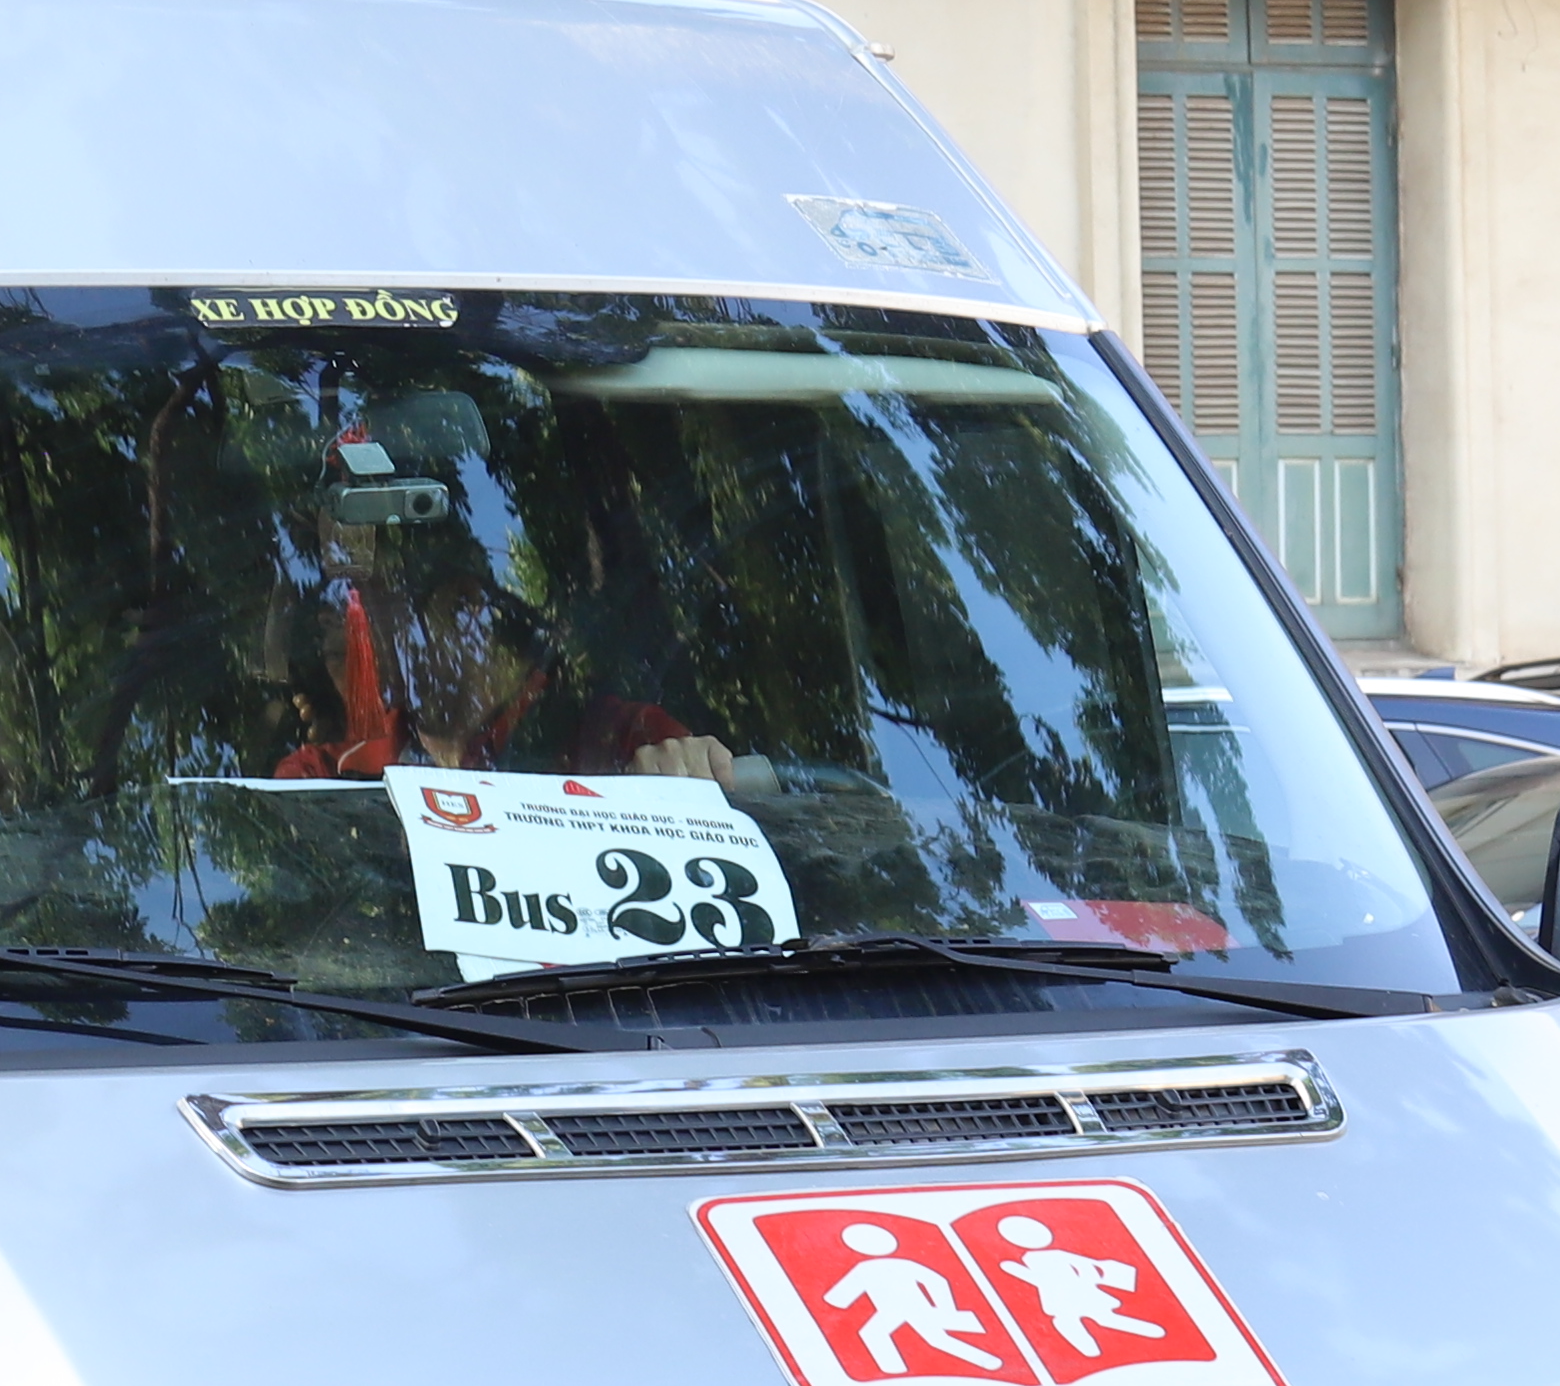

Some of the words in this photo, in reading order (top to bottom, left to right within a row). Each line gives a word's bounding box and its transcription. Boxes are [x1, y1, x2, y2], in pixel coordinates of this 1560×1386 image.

[190, 297, 244, 321] XE
[248, 295, 335, 326] HỢP
[342, 289, 459, 322] ĐỒNG
[504, 810, 565, 828] TRƯỜNG
[569, 818, 605, 832] THPT
[609, 823, 651, 836] KHOA
[655, 826, 685, 841] HỌC
[689, 827, 725, 844] GIÁO
[728, 834, 760, 849] DỤC
[520, 800, 567, 815] TRƯỜNG
[593, 810, 617, 822] HỌC
[620, 810, 648, 822] GIÁO
[651, 814, 675, 826] DỤC
[444, 862, 578, 935] Bus
[595, 847, 775, 948] 23
